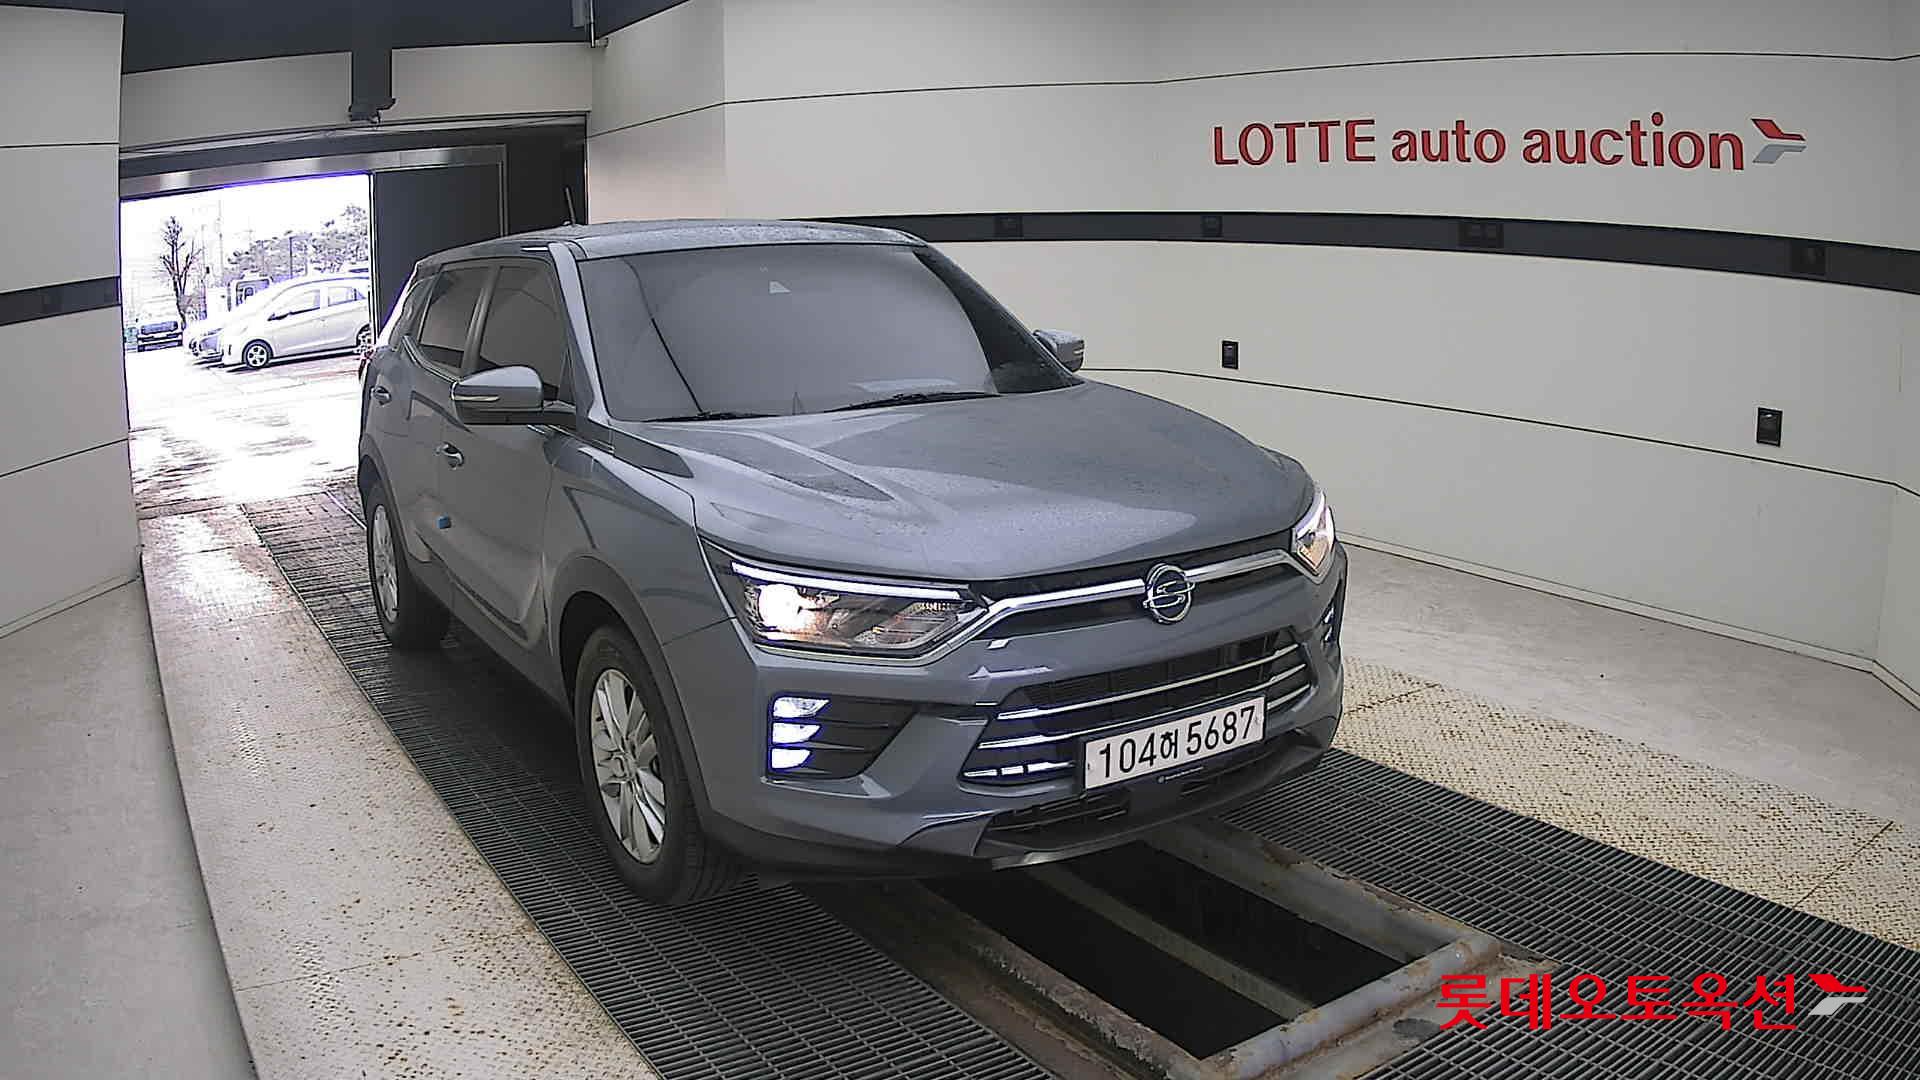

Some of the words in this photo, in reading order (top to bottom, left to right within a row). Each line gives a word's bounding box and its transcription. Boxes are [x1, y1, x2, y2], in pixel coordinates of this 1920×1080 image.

[1214, 118, 1376, 165] LOTTE
[1391, 119, 1506, 164] auto
[1522, 112, 1744, 170] auction
[1186, 705, 1256, 755] 5687
